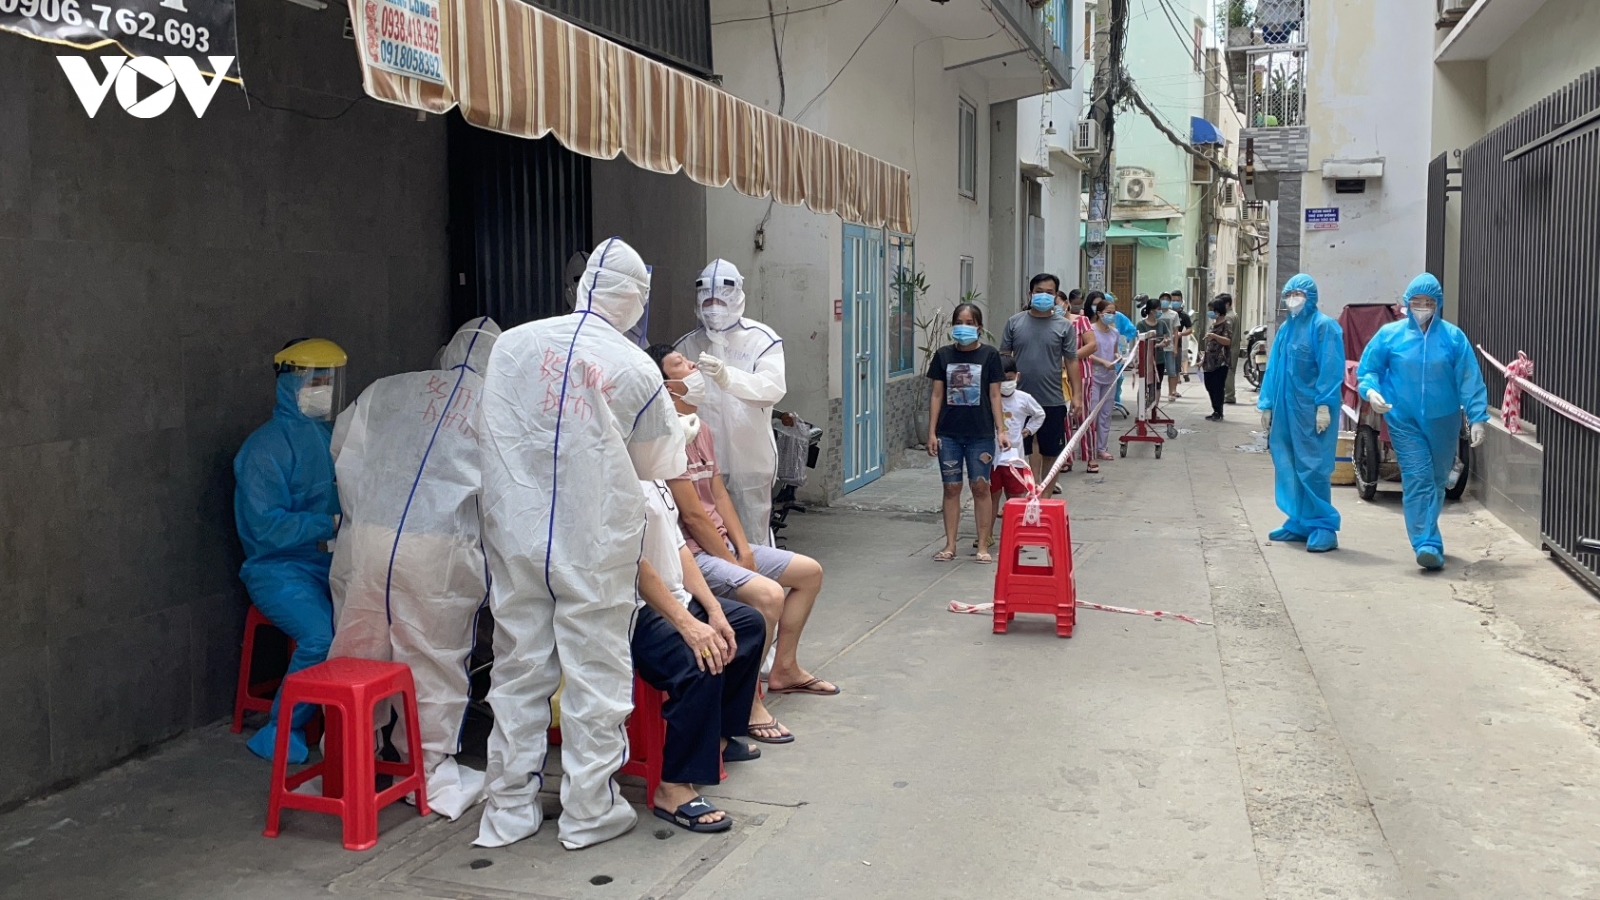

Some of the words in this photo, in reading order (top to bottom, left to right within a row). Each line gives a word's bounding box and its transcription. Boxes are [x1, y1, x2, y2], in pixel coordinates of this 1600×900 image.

[409, 0, 431, 18] LONG
[382, 6, 439, 54] 0938.418.392
[380, 39, 441, 77] 0918058392
